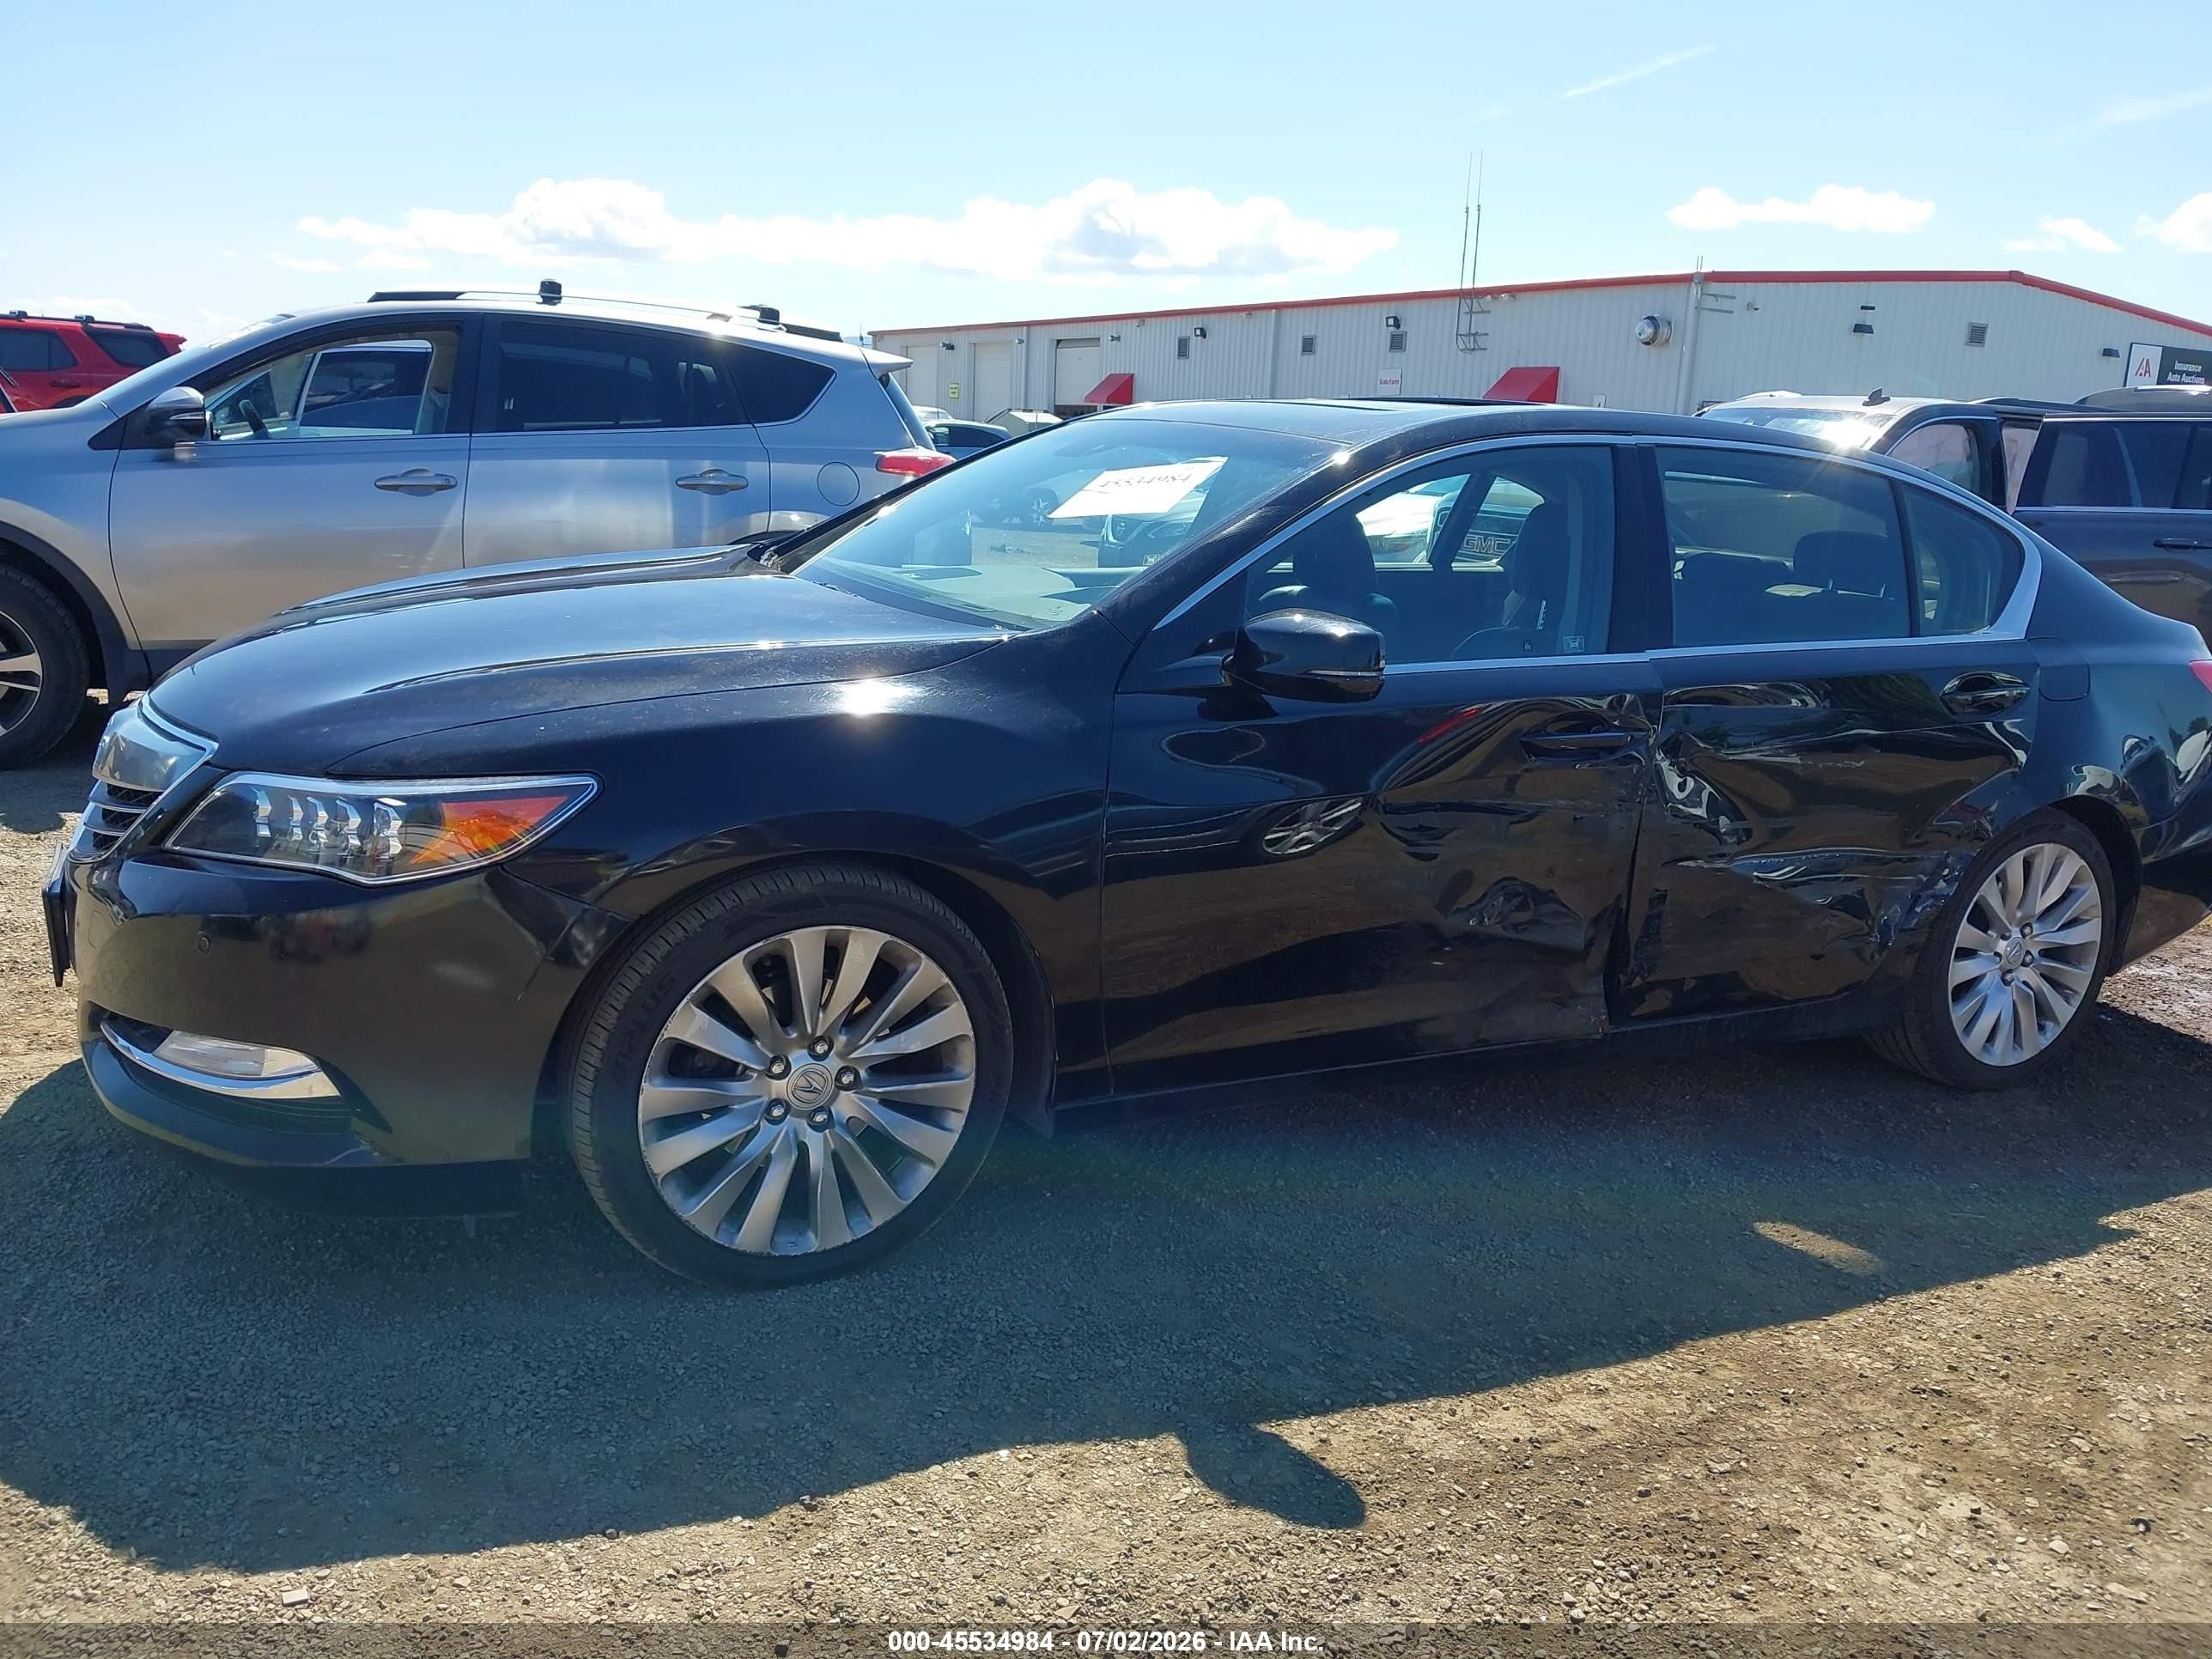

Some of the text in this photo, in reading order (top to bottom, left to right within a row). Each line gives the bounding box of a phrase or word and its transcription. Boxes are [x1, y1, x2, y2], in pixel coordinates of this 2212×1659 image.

[2174, 360, 2203, 373] Insurance
[2166, 372, 2205, 385] Auto Auctions
[1462, 533, 1511, 555] GMC
